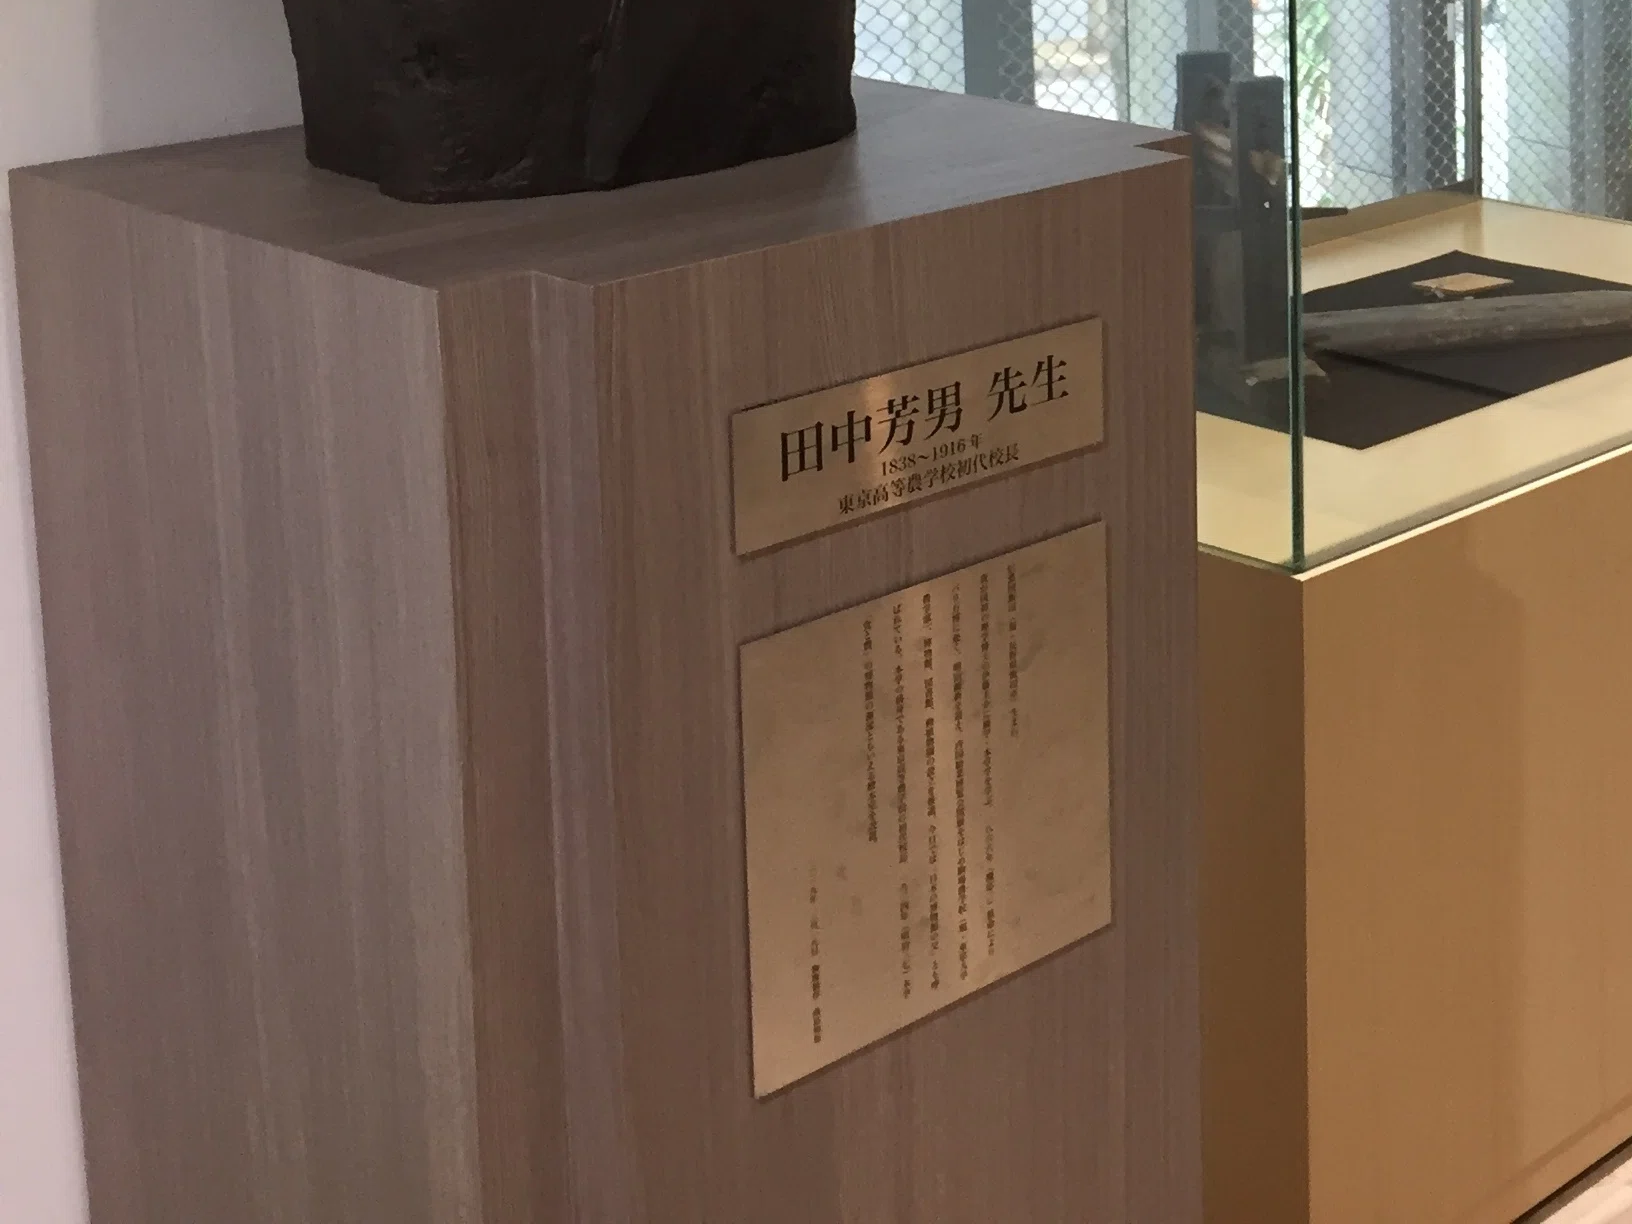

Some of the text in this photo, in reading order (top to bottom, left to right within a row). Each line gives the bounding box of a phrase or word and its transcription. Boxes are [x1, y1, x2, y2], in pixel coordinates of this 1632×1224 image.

[780, 354, 1069, 482] 田中芳男 先生
[838, 443, 1020, 515] 東京高等農学校初代校長
